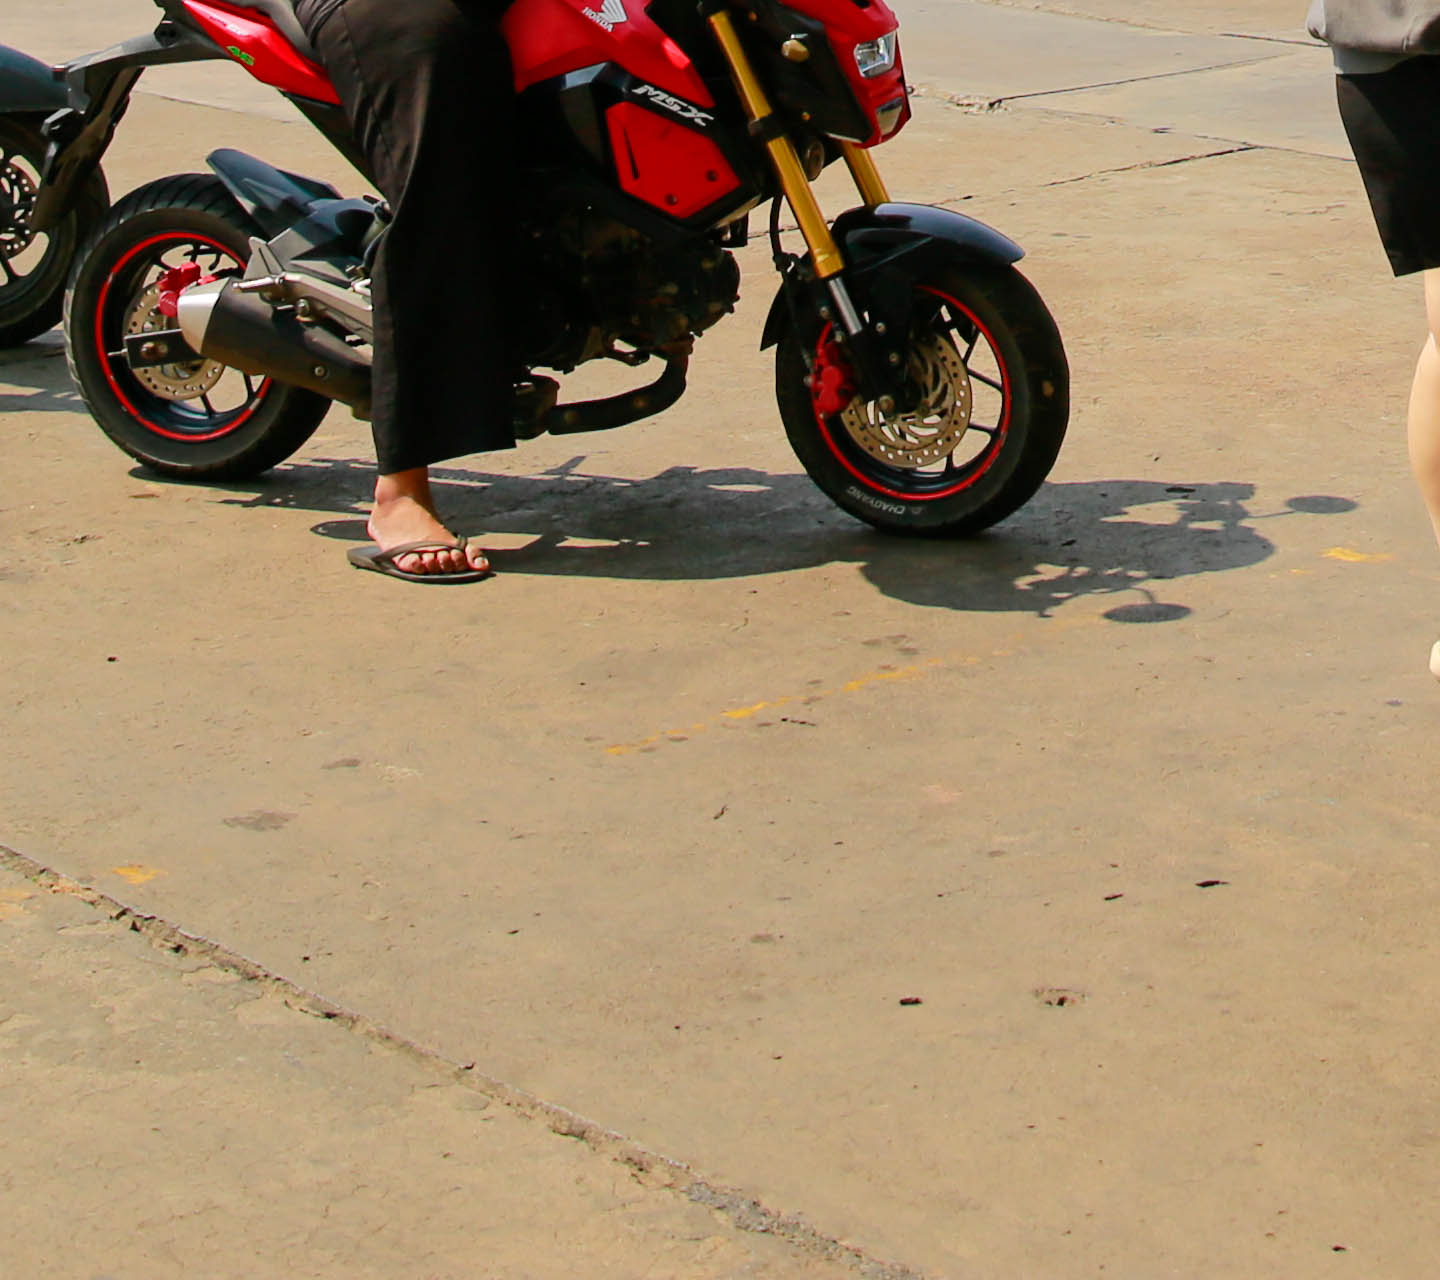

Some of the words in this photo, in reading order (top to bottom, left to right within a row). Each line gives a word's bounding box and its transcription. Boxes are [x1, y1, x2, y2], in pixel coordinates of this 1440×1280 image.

[581, 5, 614, 32] HONDA
[631, 84, 715, 127] MSX
[846, 485, 906, 515] CHAOYANG
